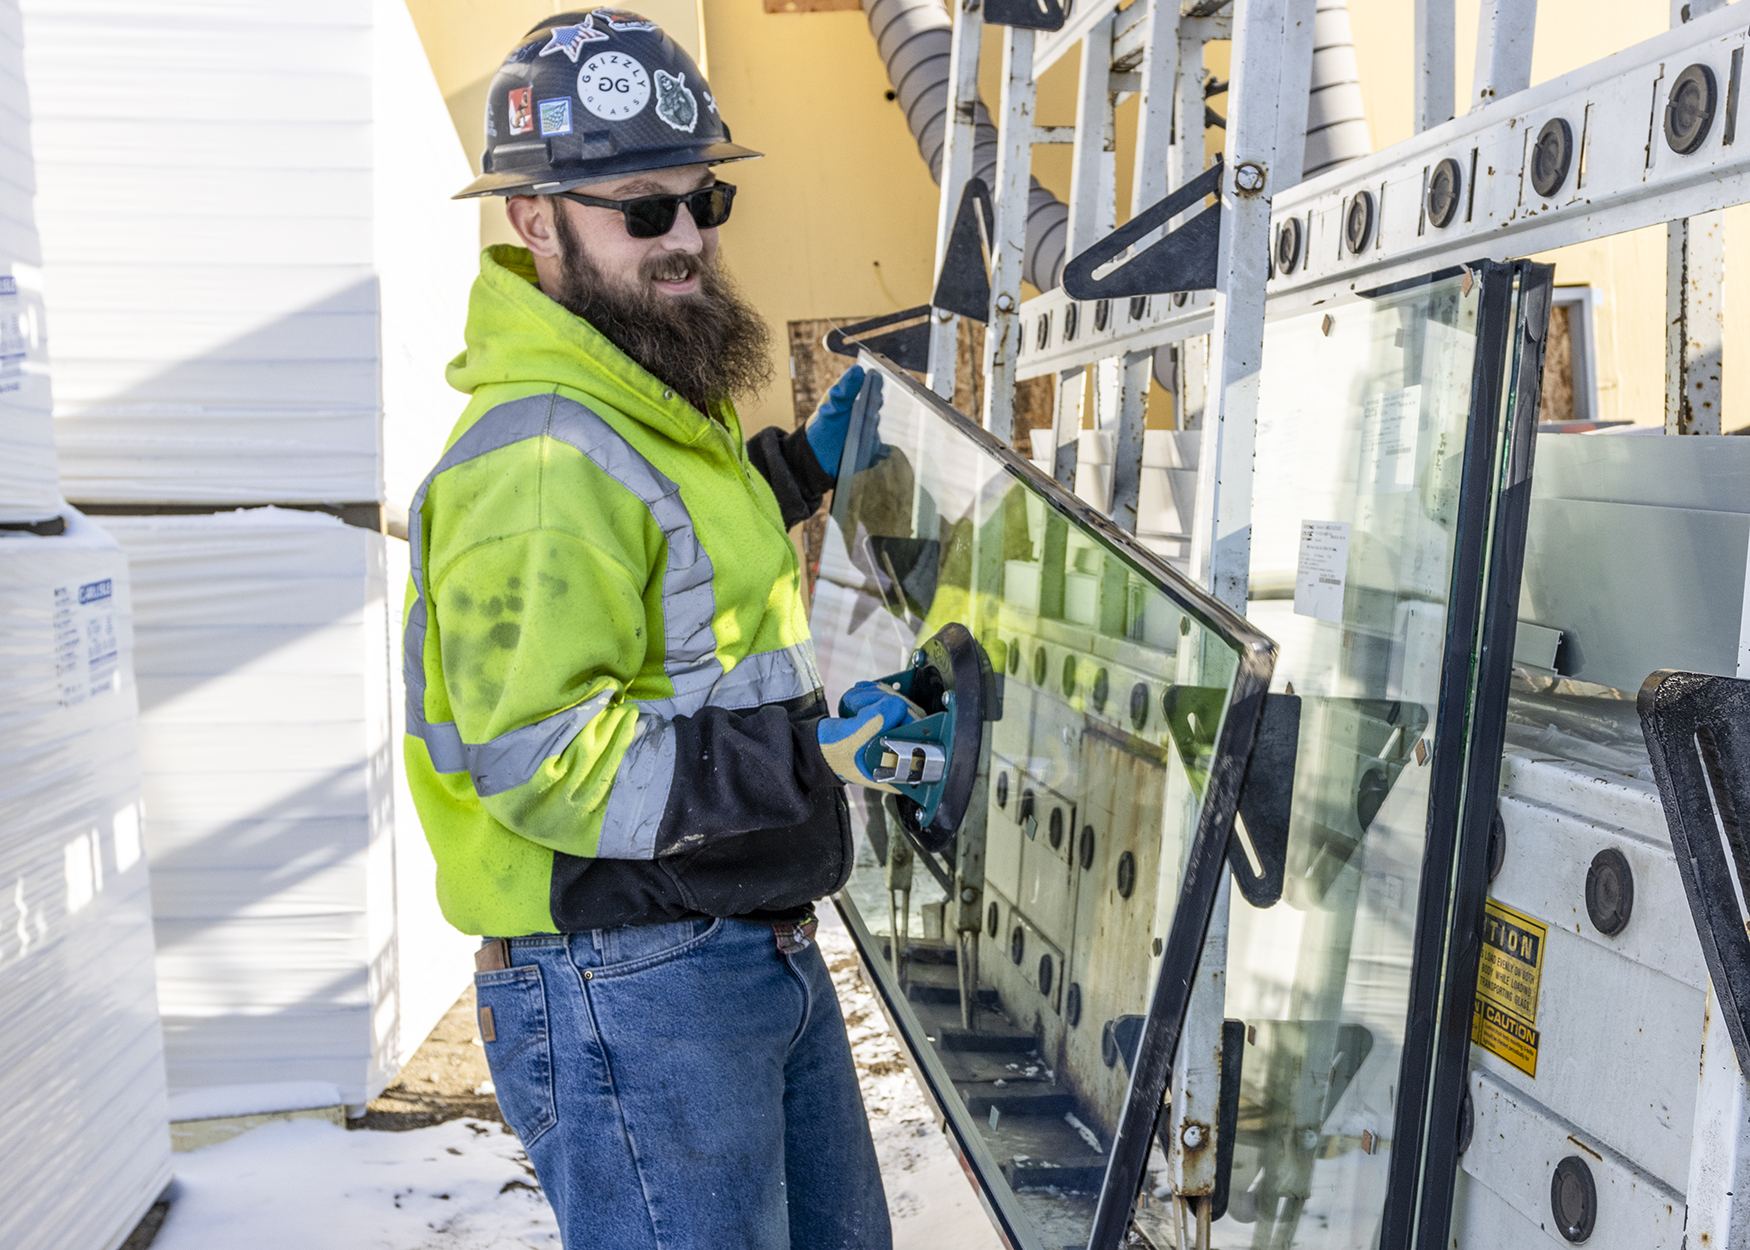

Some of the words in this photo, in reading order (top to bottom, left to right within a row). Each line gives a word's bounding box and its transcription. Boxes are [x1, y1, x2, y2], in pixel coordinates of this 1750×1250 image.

[582, 55, 646, 87] GRIZZLY
[587, 96, 640, 114] GLASS
[1496, 957, 1514, 974] EVENLY
[1479, 975, 1513, 1002] TRANSPORTING
[1486, 1006, 1536, 1046] CAUTION
